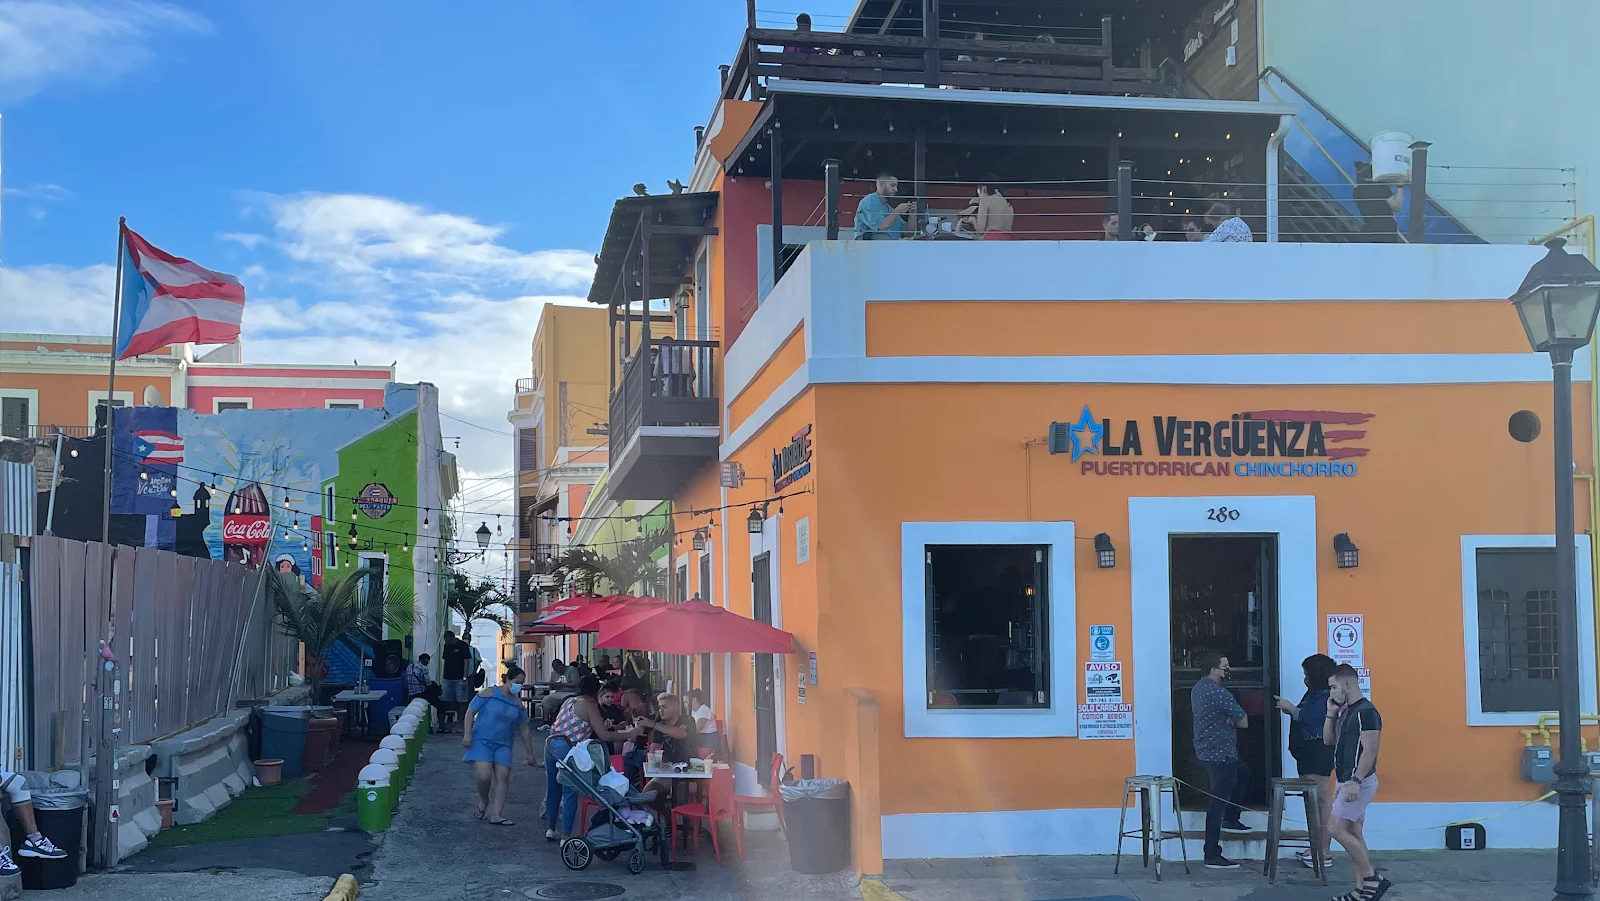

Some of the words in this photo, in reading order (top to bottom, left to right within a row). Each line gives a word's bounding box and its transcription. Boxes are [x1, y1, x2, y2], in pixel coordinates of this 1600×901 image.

[1102, 418, 1143, 457] LA
[1153, 412, 1327, 458] VERGÜENZA
[1081, 461, 1230, 477] PUERTORRICAN
[1234, 461, 1358, 477] CHINCHORRO
[1207, 506, 1241, 523] 280
[224, 520, 270, 539] Coca-Cola
[1089, 663, 1118, 671] AVISO
[1357, 668, 1370, 677] OUT
[1078, 704, 1095, 713] SOLO
[1096, 704, 1118, 712] CARRY
[1119, 704, 1132, 712] OUT
